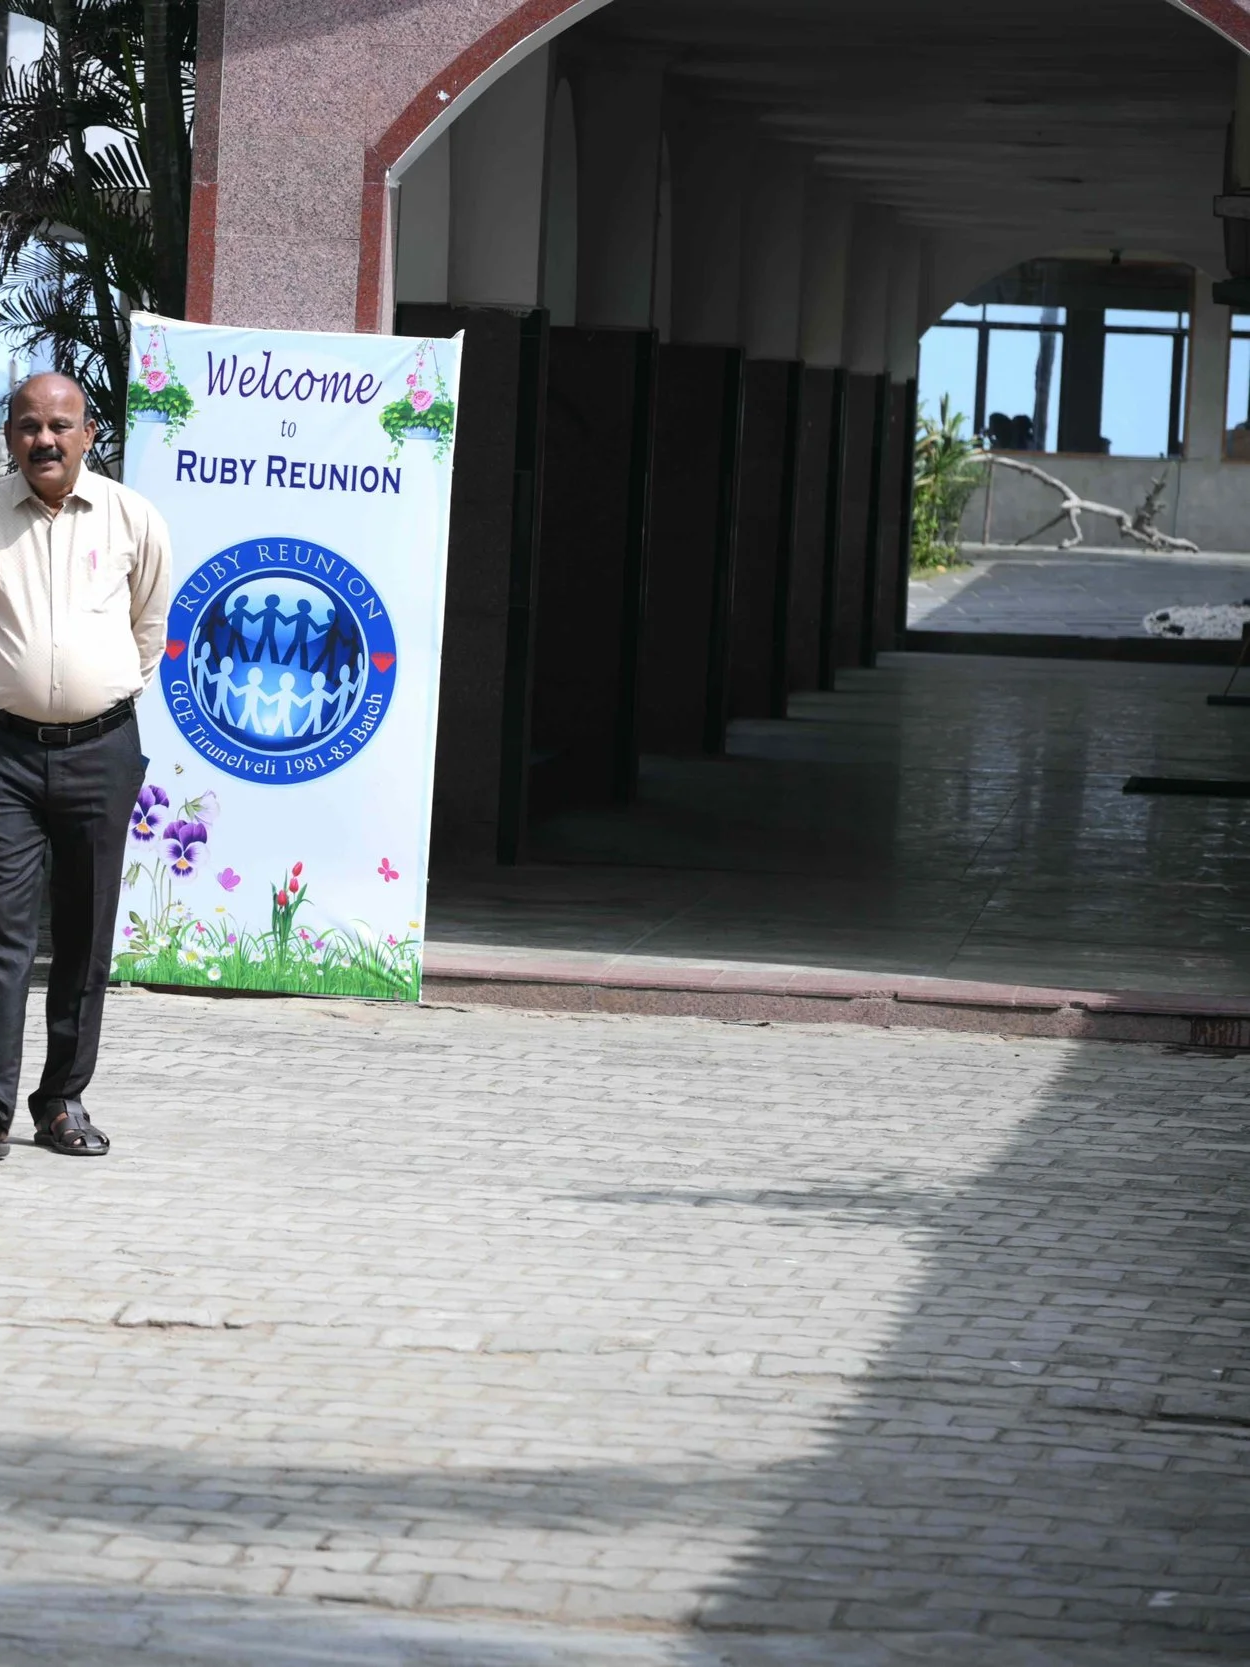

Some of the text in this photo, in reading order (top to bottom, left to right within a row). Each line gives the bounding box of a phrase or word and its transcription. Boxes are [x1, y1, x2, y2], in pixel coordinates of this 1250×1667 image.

[207, 350, 383, 405] Welcome
[280, 418, 297, 438] to
[175, 449, 402, 494] RUBY REUNION
[175, 543, 383, 620] RUBY REUNION
[169, 679, 384, 776] GCE Tirunelveli 1981-85 Batch
